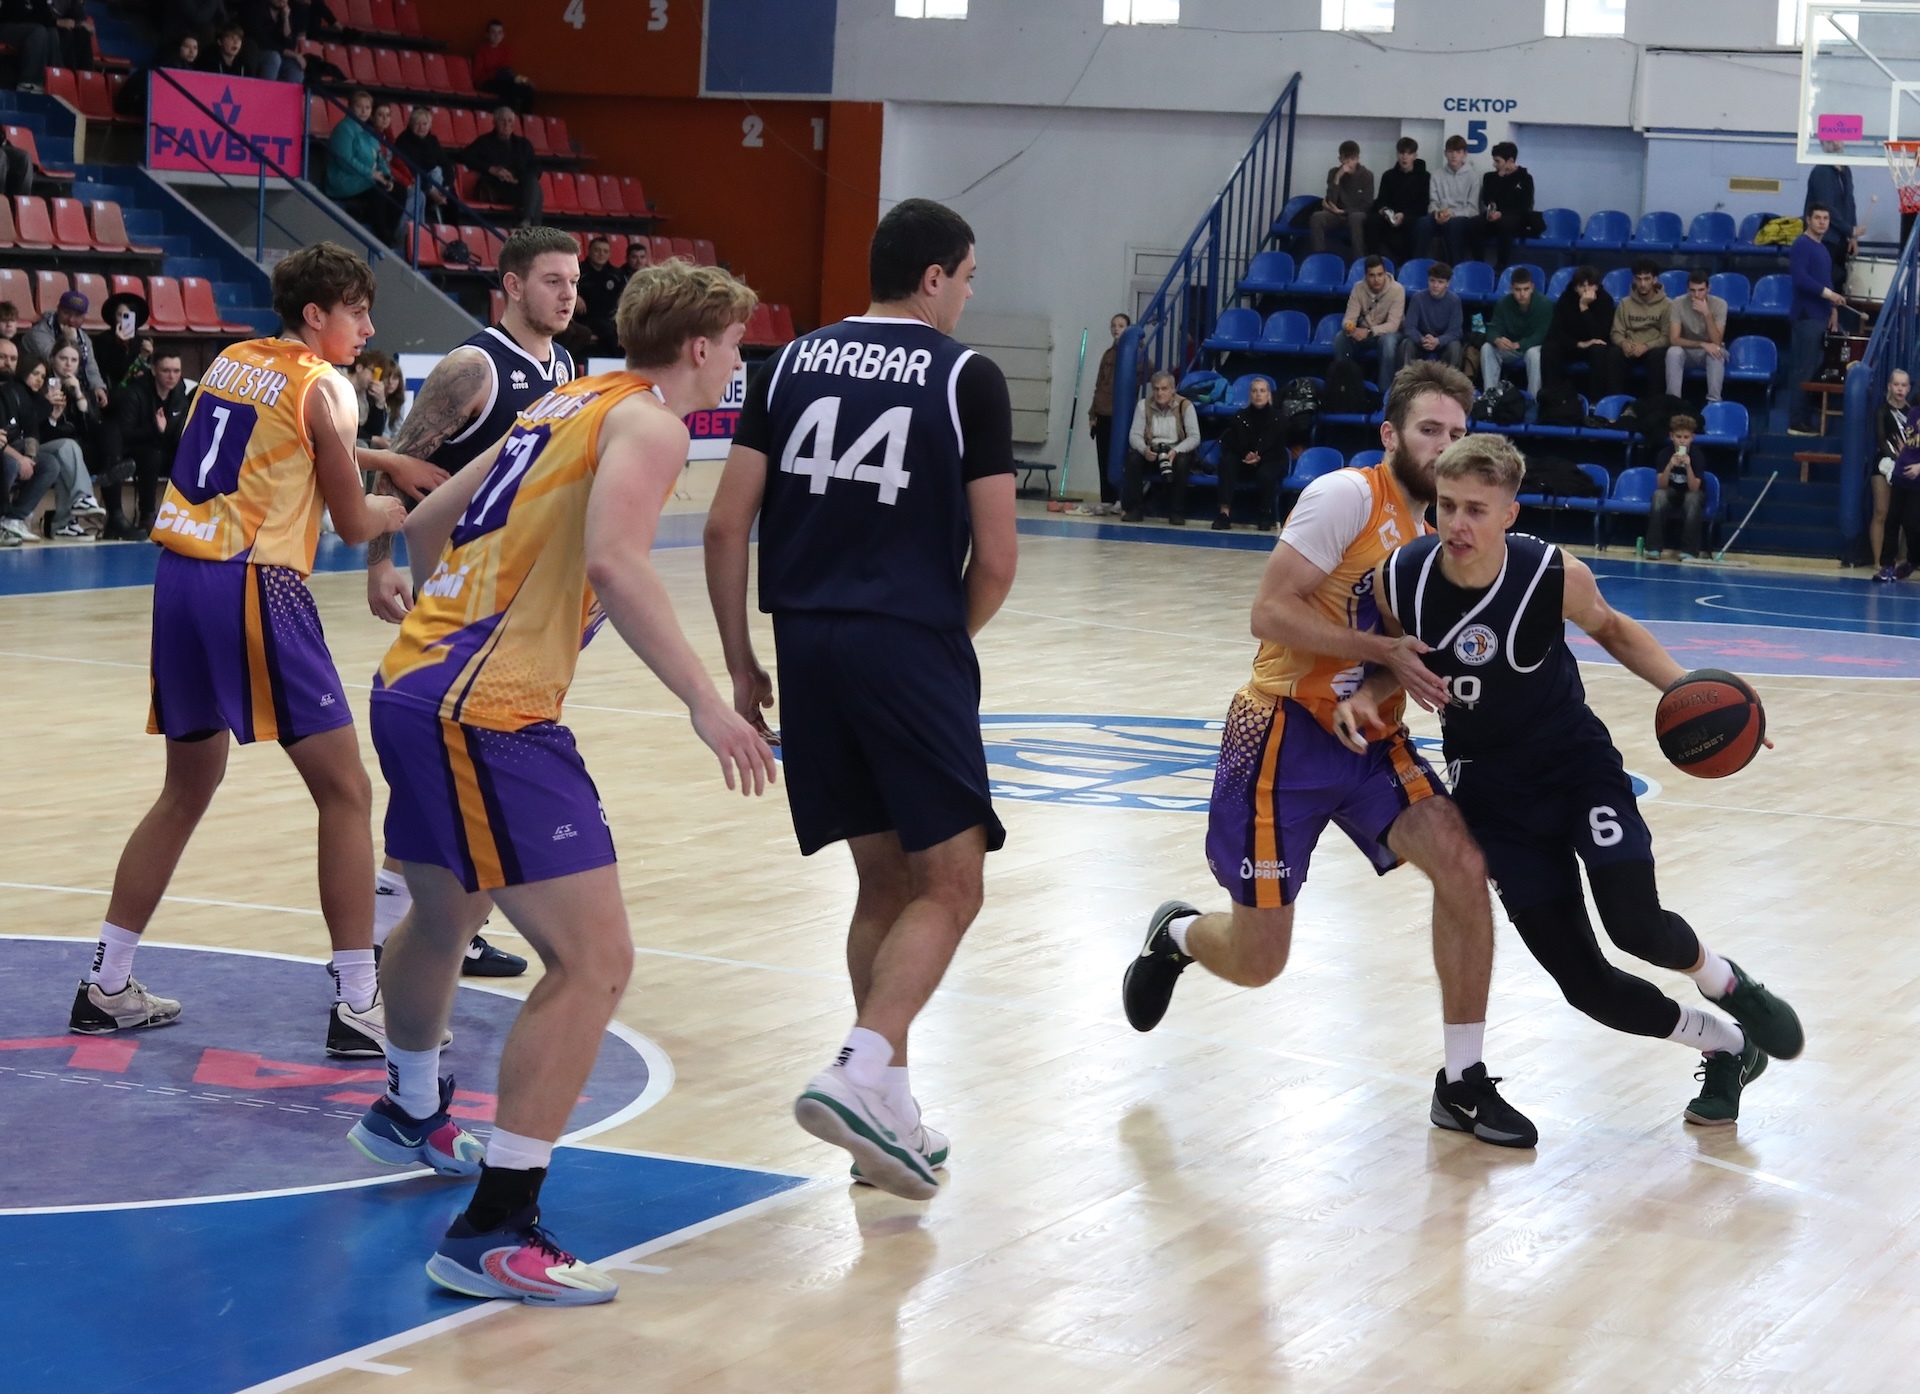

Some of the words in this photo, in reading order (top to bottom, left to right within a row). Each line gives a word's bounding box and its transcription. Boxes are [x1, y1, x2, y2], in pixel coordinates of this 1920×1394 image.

[564, 0, 585, 29] 4
[647, 0, 668, 31] 3
[1443, 97, 1518, 113] СЕКТОР
[154, 126, 292, 165] FAVBET
[742, 115, 764, 147] 2
[811, 118, 824, 150] 1
[1467, 120, 1488, 154] 5
[792, 338, 932, 387] HARBAR
[198, 406, 231, 488] 1
[780, 395, 913, 506] 44
[1684, 733, 1724, 758] FAVBET
[1589, 805, 1624, 847] 6
[1254, 867, 1292, 879] PRINT
